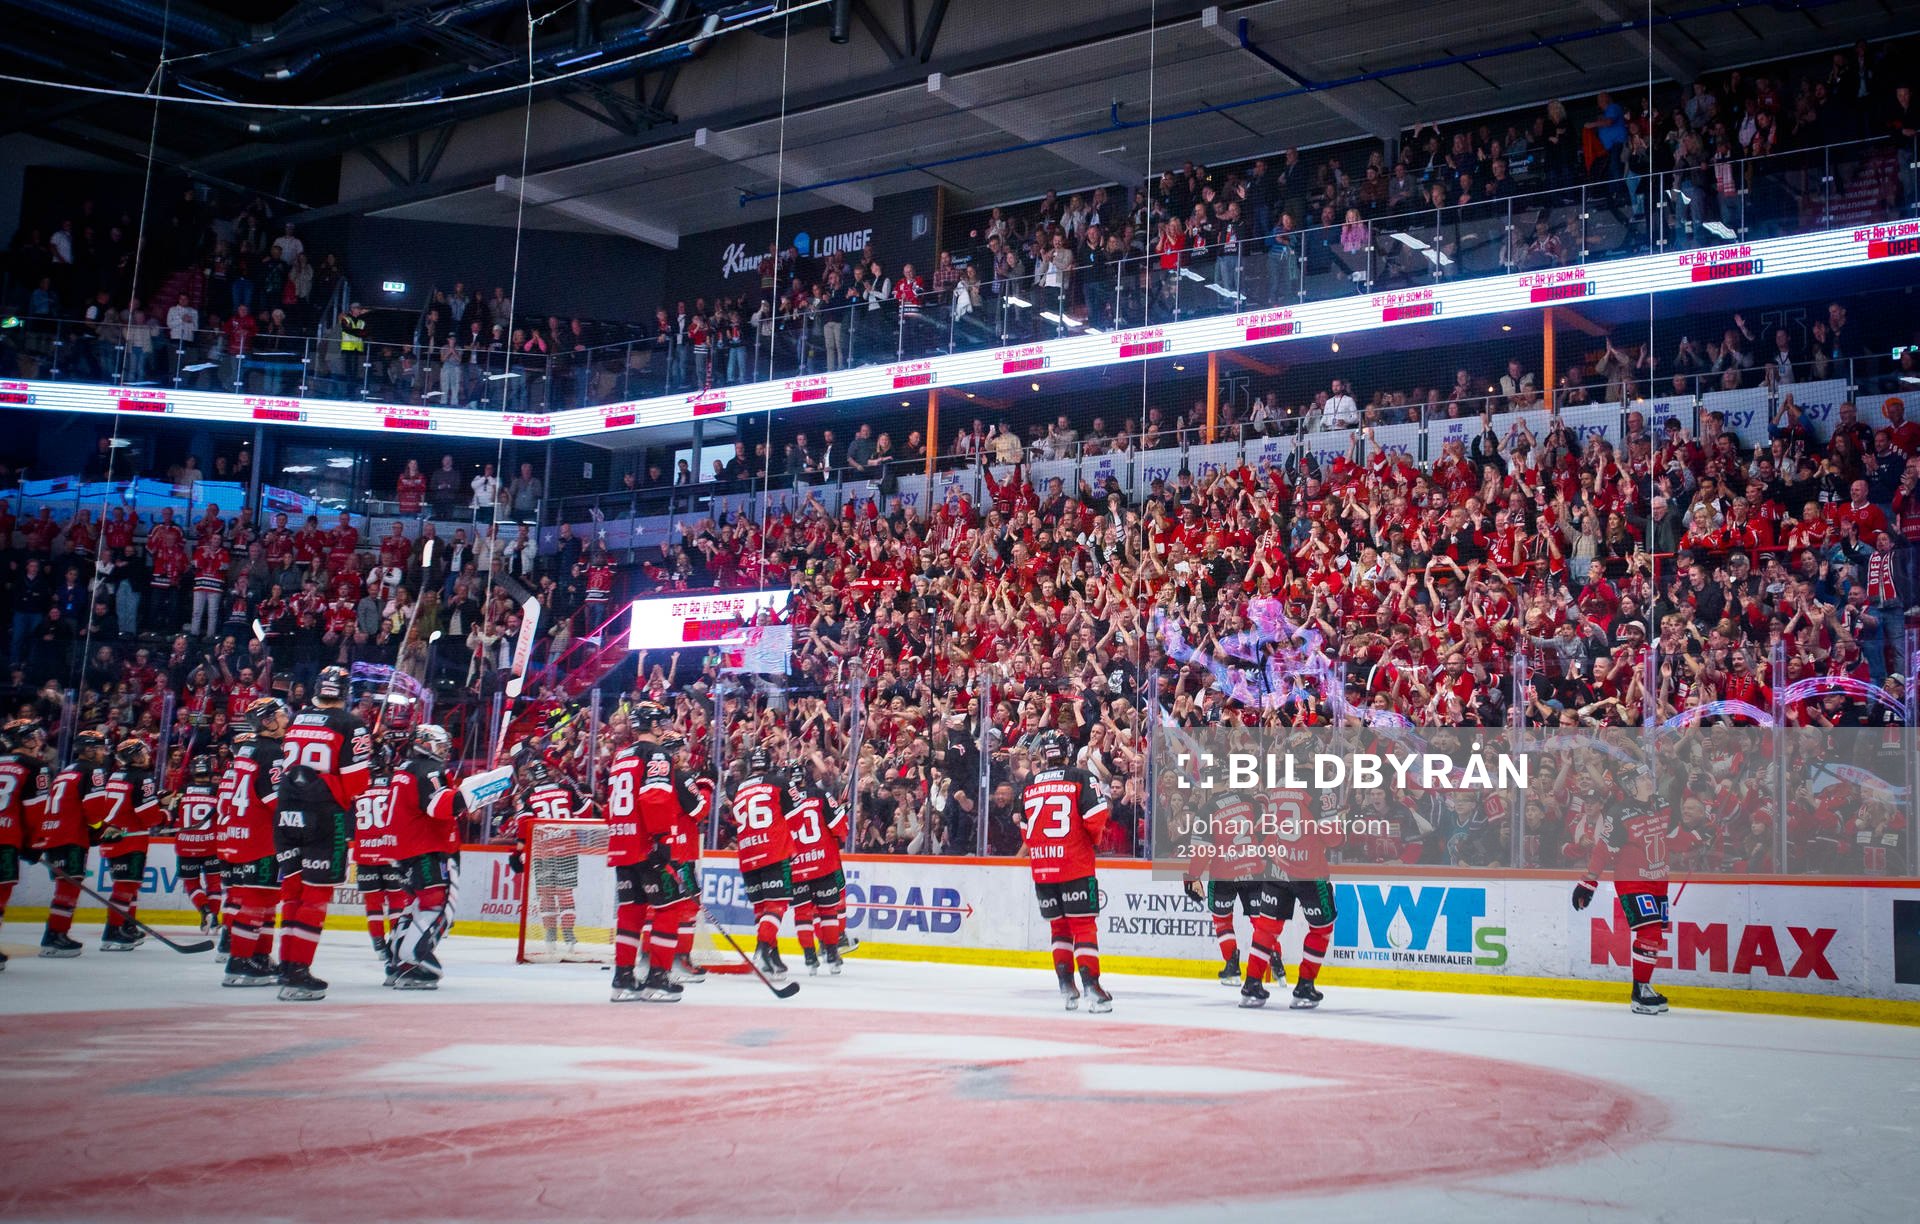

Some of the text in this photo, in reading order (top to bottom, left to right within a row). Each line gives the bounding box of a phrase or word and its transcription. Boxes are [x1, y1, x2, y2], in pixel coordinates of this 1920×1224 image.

[1854, 229, 1870, 242] DET
[1888, 226, 1897, 238] VI
[1898, 222, 1918, 236] SOM
[813, 228, 873, 258] LOUNGE
[1679, 254, 1694, 266] DET
[1710, 251, 1718, 262] VI
[1720, 248, 1737, 260] SOM
[1655, 403, 1670, 413] WE
[1801, 403, 1832, 421] tsy
[1722, 410, 1755, 428] tsy
[1449, 424, 1462, 433] WE
[1264, 443, 1277, 452] WE
[1024, 795, 1072, 840] 73
[1030, 846, 1064, 859] EKLIND
[480, 903, 513, 916] ROAD
[1333, 950, 1473, 966] RENT VATTEN UTAN KEMIKALIER
